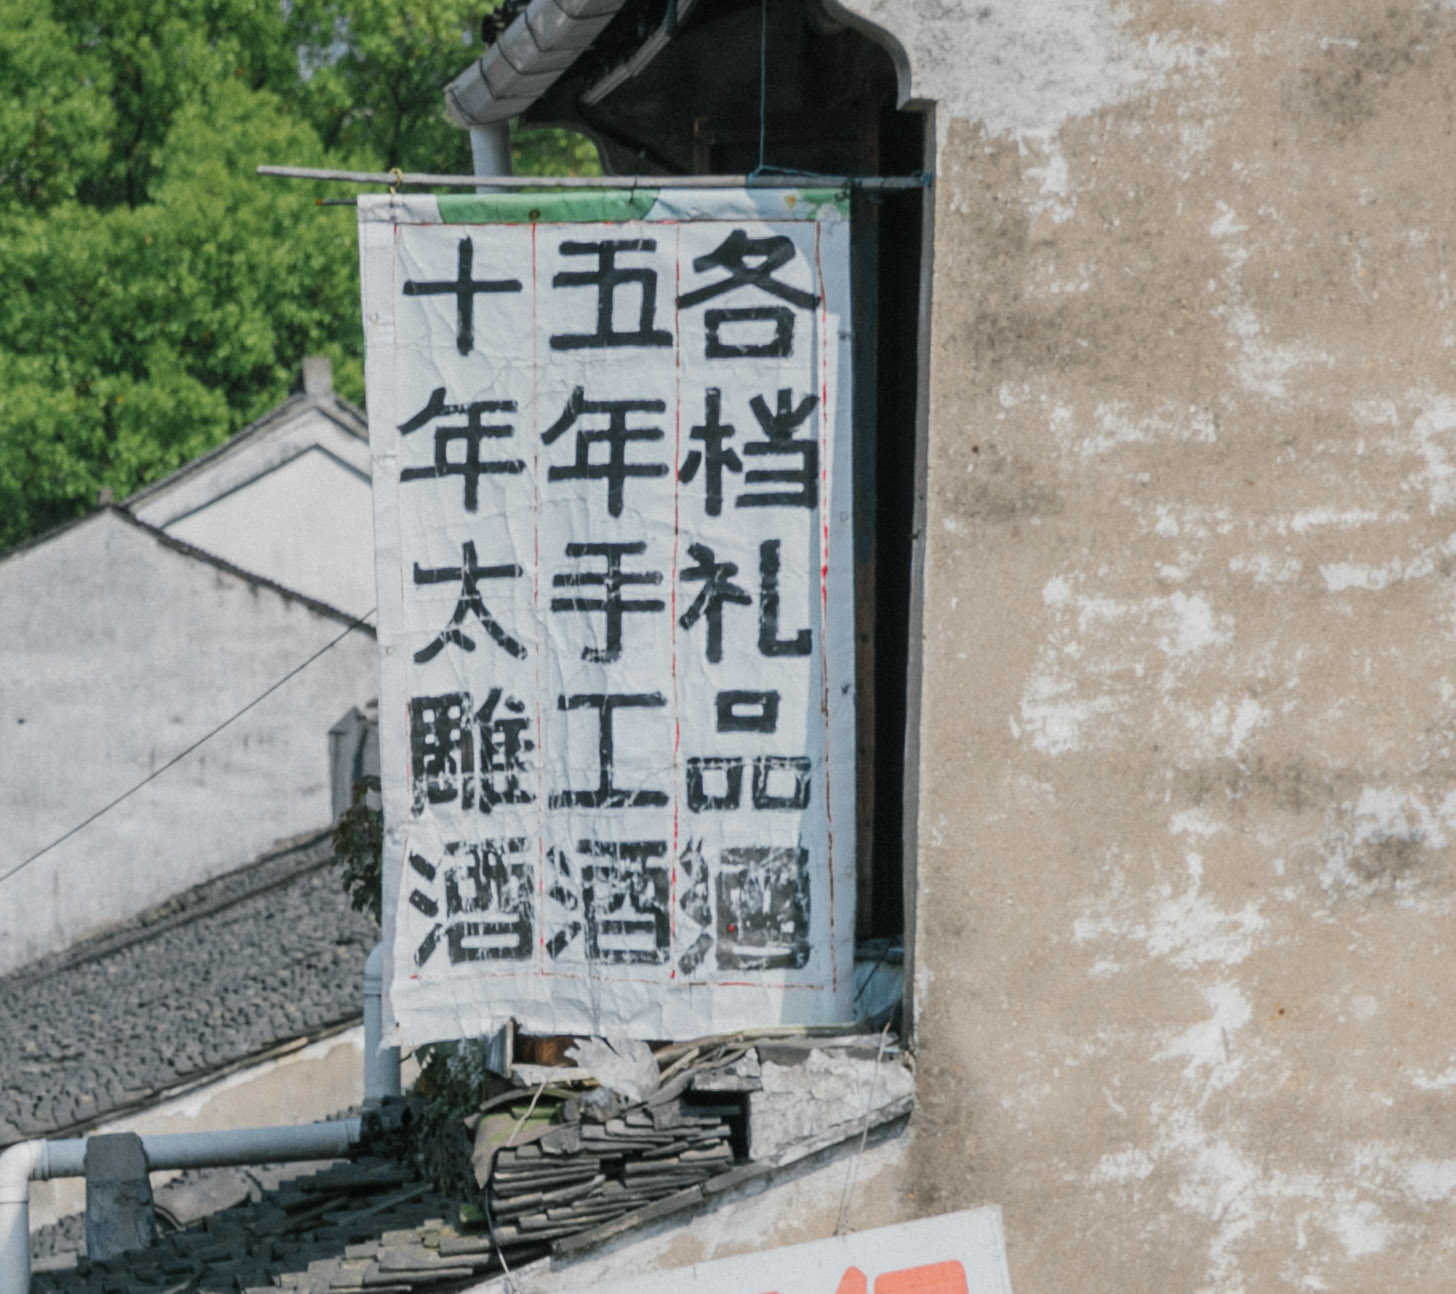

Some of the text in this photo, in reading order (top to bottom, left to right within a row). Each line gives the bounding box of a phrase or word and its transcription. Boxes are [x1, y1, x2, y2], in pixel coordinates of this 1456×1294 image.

[541, 237, 674, 966] 五年手工酒
